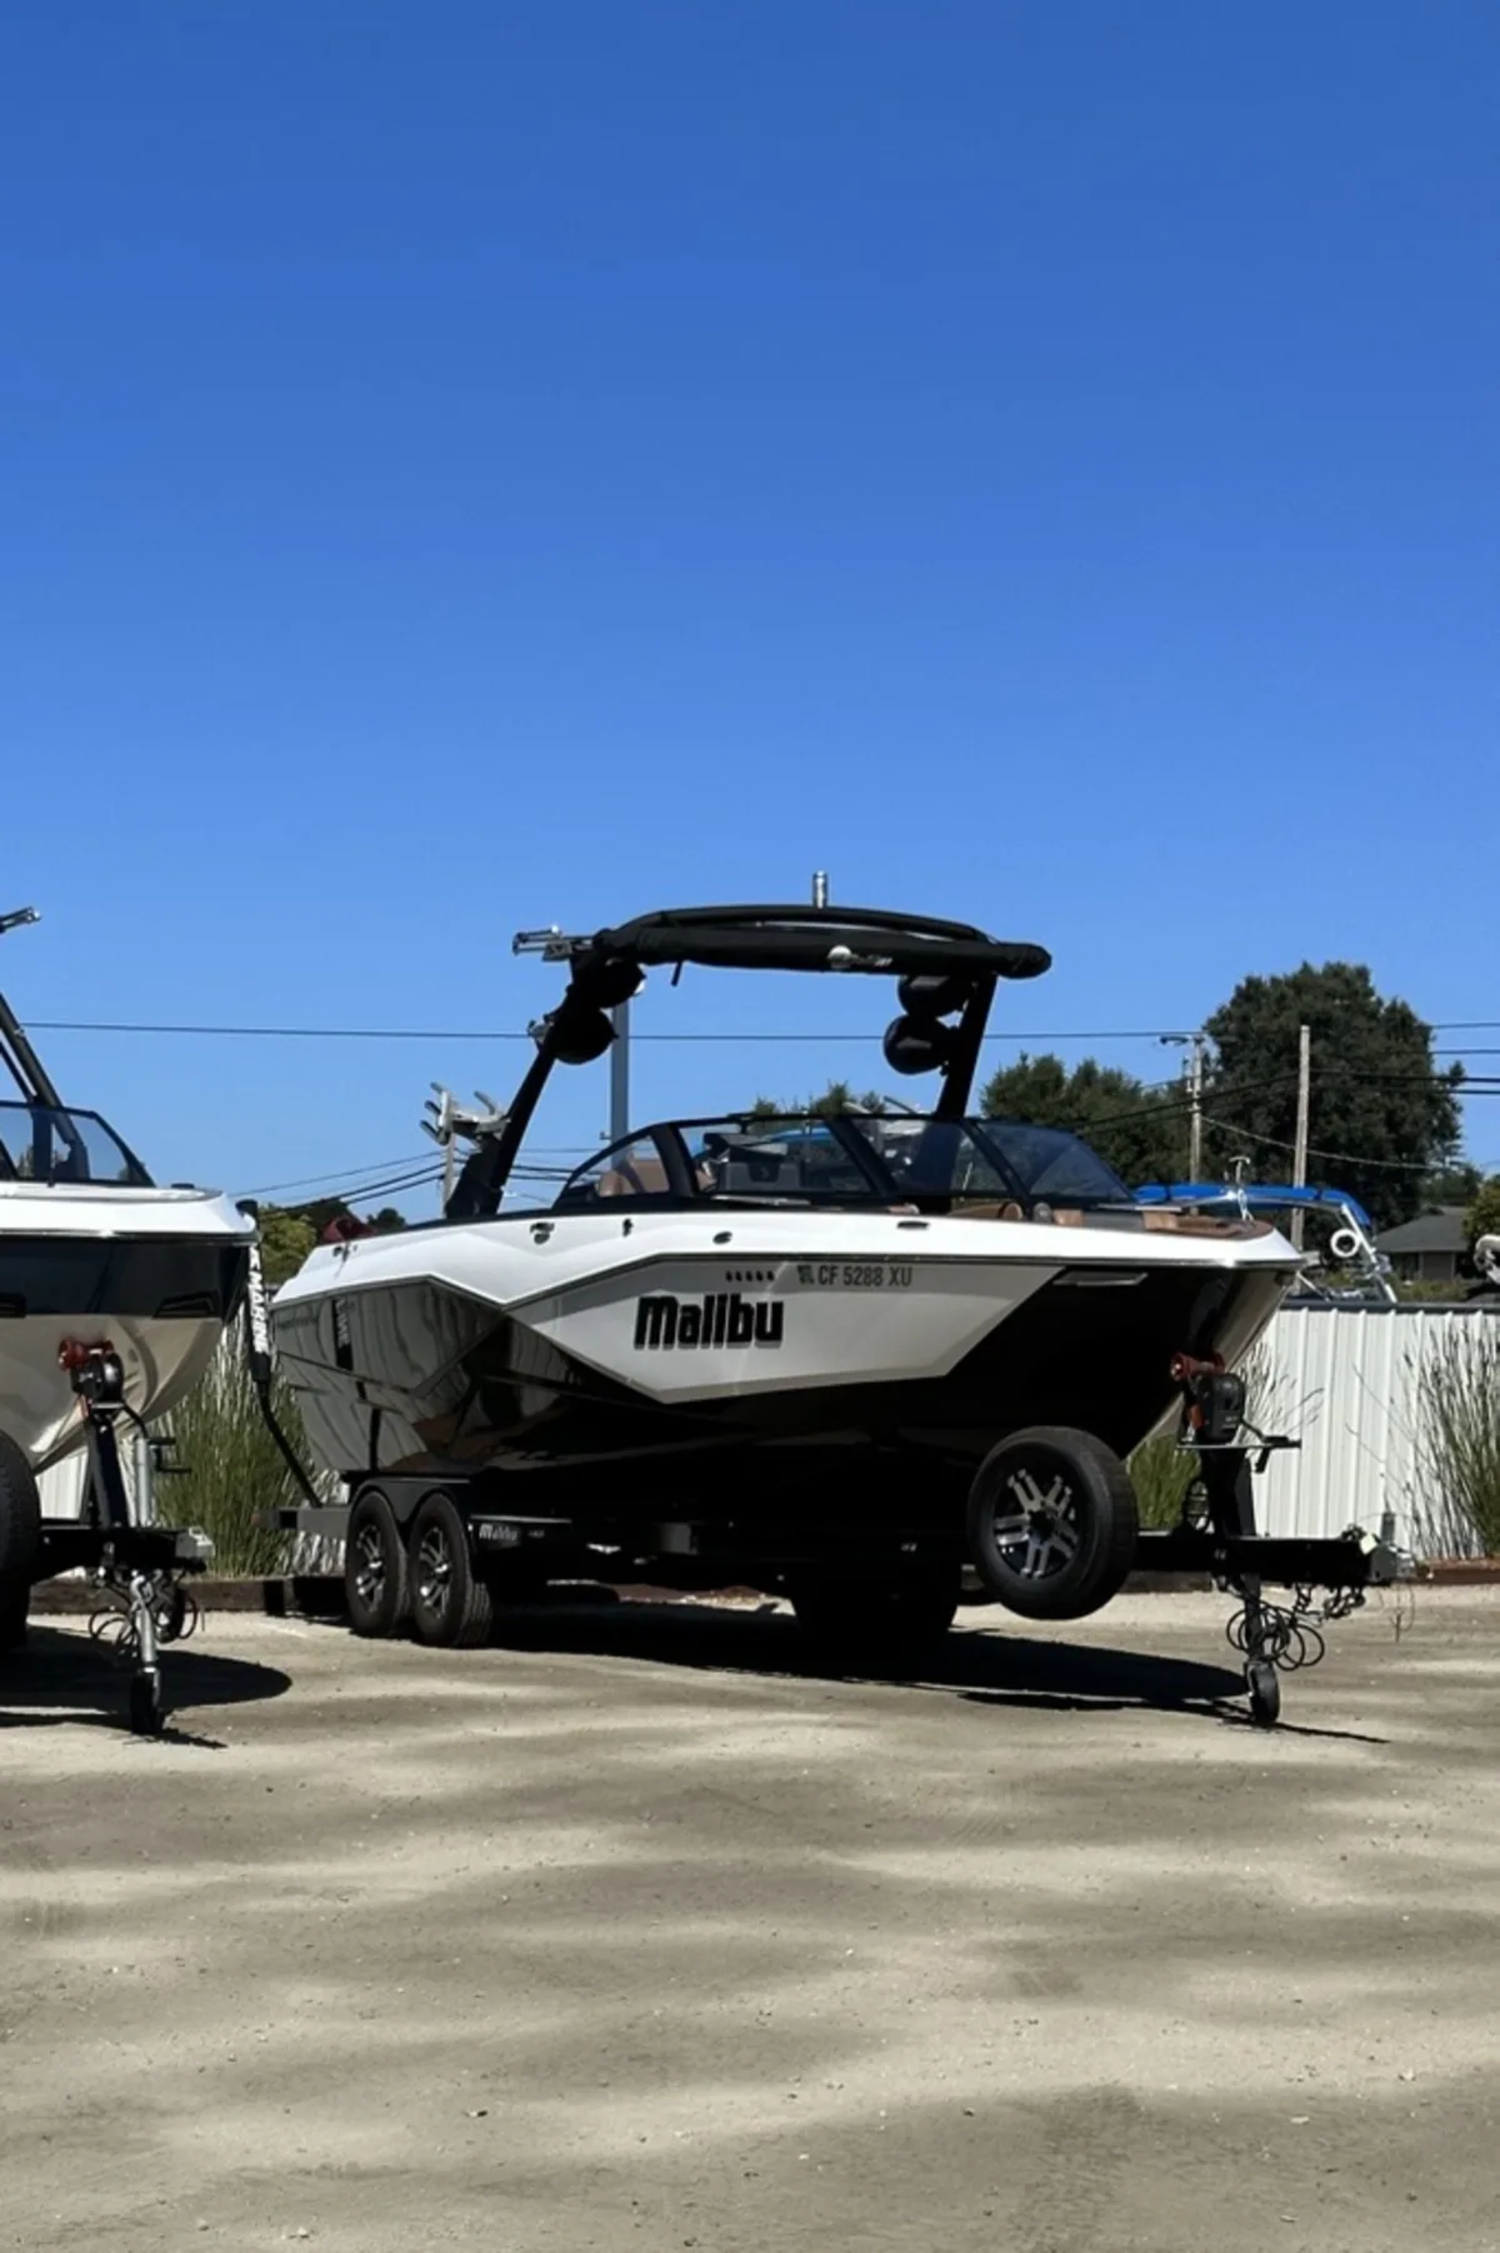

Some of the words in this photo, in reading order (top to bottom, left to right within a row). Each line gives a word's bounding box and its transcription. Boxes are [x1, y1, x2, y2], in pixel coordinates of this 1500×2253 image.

[818, 1264, 839, 1285] CF
[843, 1265, 884, 1287] 5288
[888, 1266, 914, 1287] XU
[247, 1271, 269, 1355] MARINE
[633, 1293, 784, 1350] Malibu
